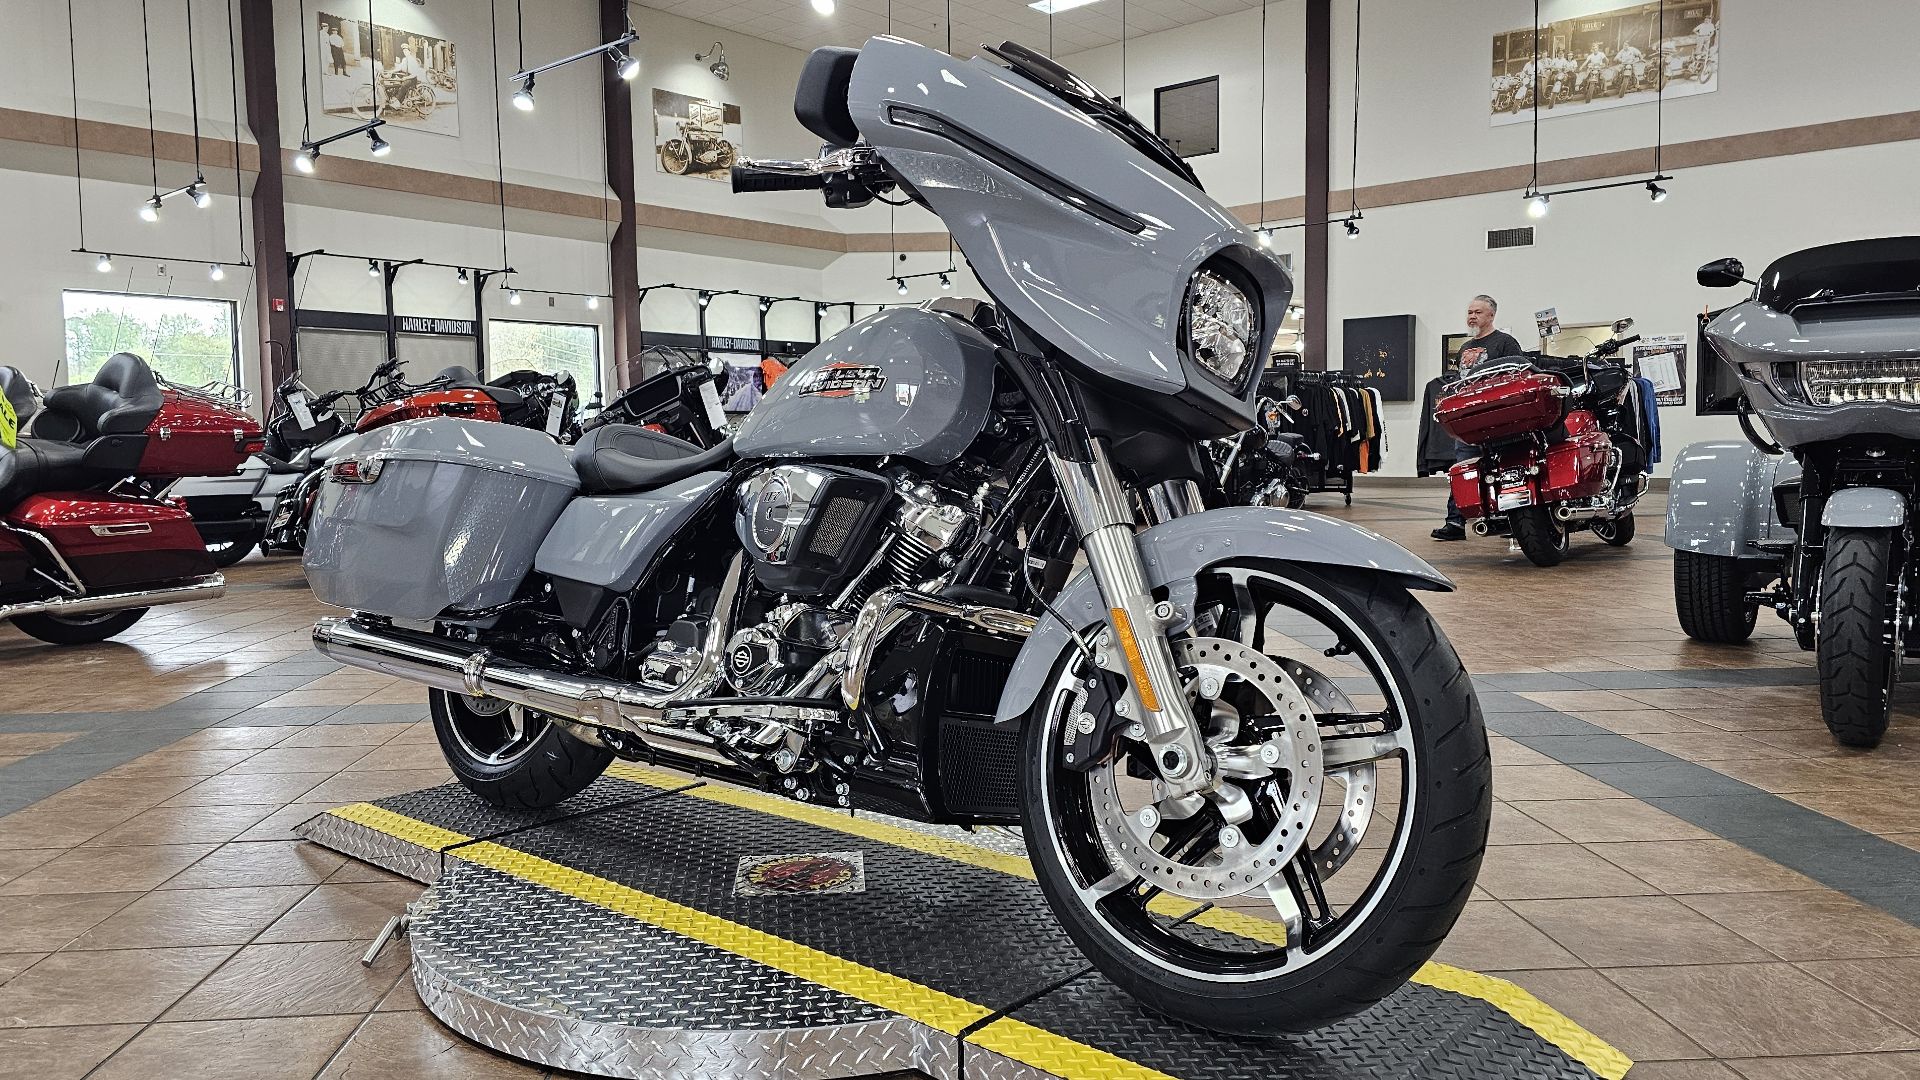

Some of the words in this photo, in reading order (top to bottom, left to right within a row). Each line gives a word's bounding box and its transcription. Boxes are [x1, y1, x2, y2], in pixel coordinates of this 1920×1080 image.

[402, 317, 472, 335] HARLEY-DAVIDSON
[711, 337, 760, 351] HARLEY-DAVIDSON
[0, 403, 16, 430] ALE
